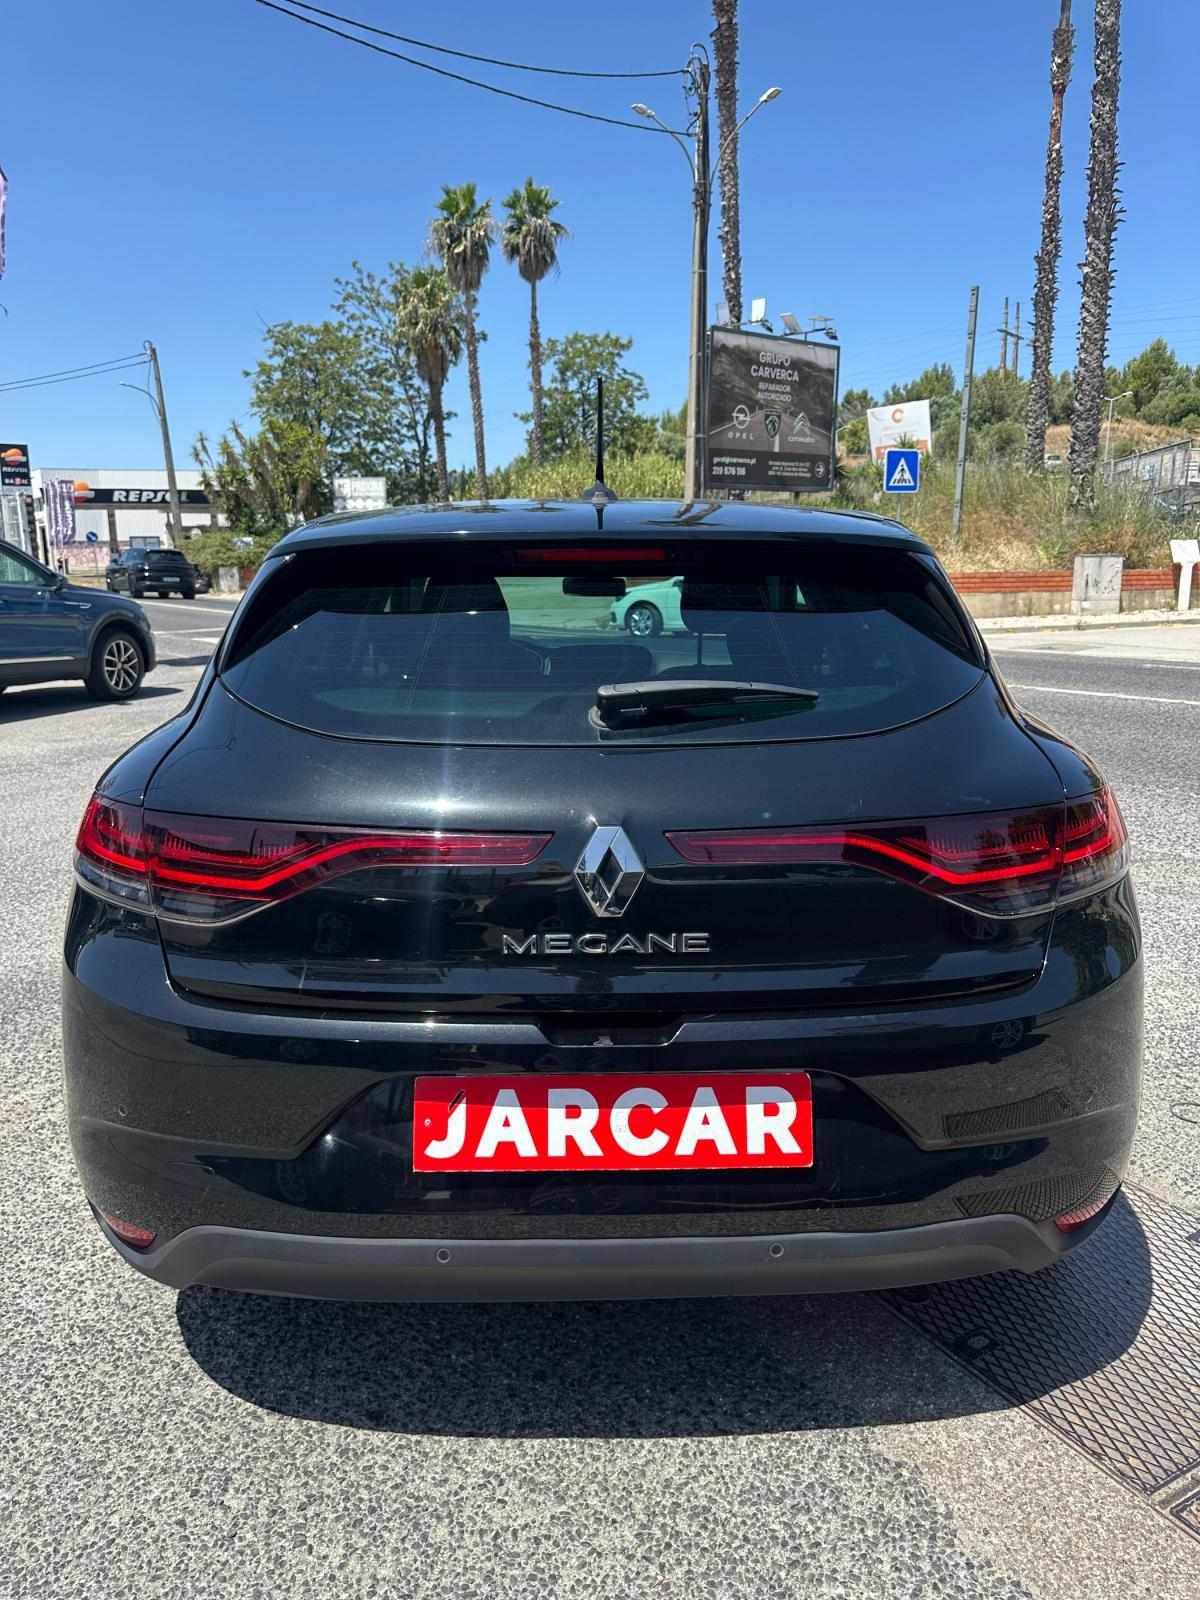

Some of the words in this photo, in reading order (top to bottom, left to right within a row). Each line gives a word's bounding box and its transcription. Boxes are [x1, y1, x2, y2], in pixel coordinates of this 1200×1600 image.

[760, 352, 790, 367] GRUPO
[750, 365, 799, 382] CARVERCA
[727, 431, 753, 440] OPEL
[502, 933, 711, 954] MEGANE
[424, 1086, 802, 1159] JARCAR
